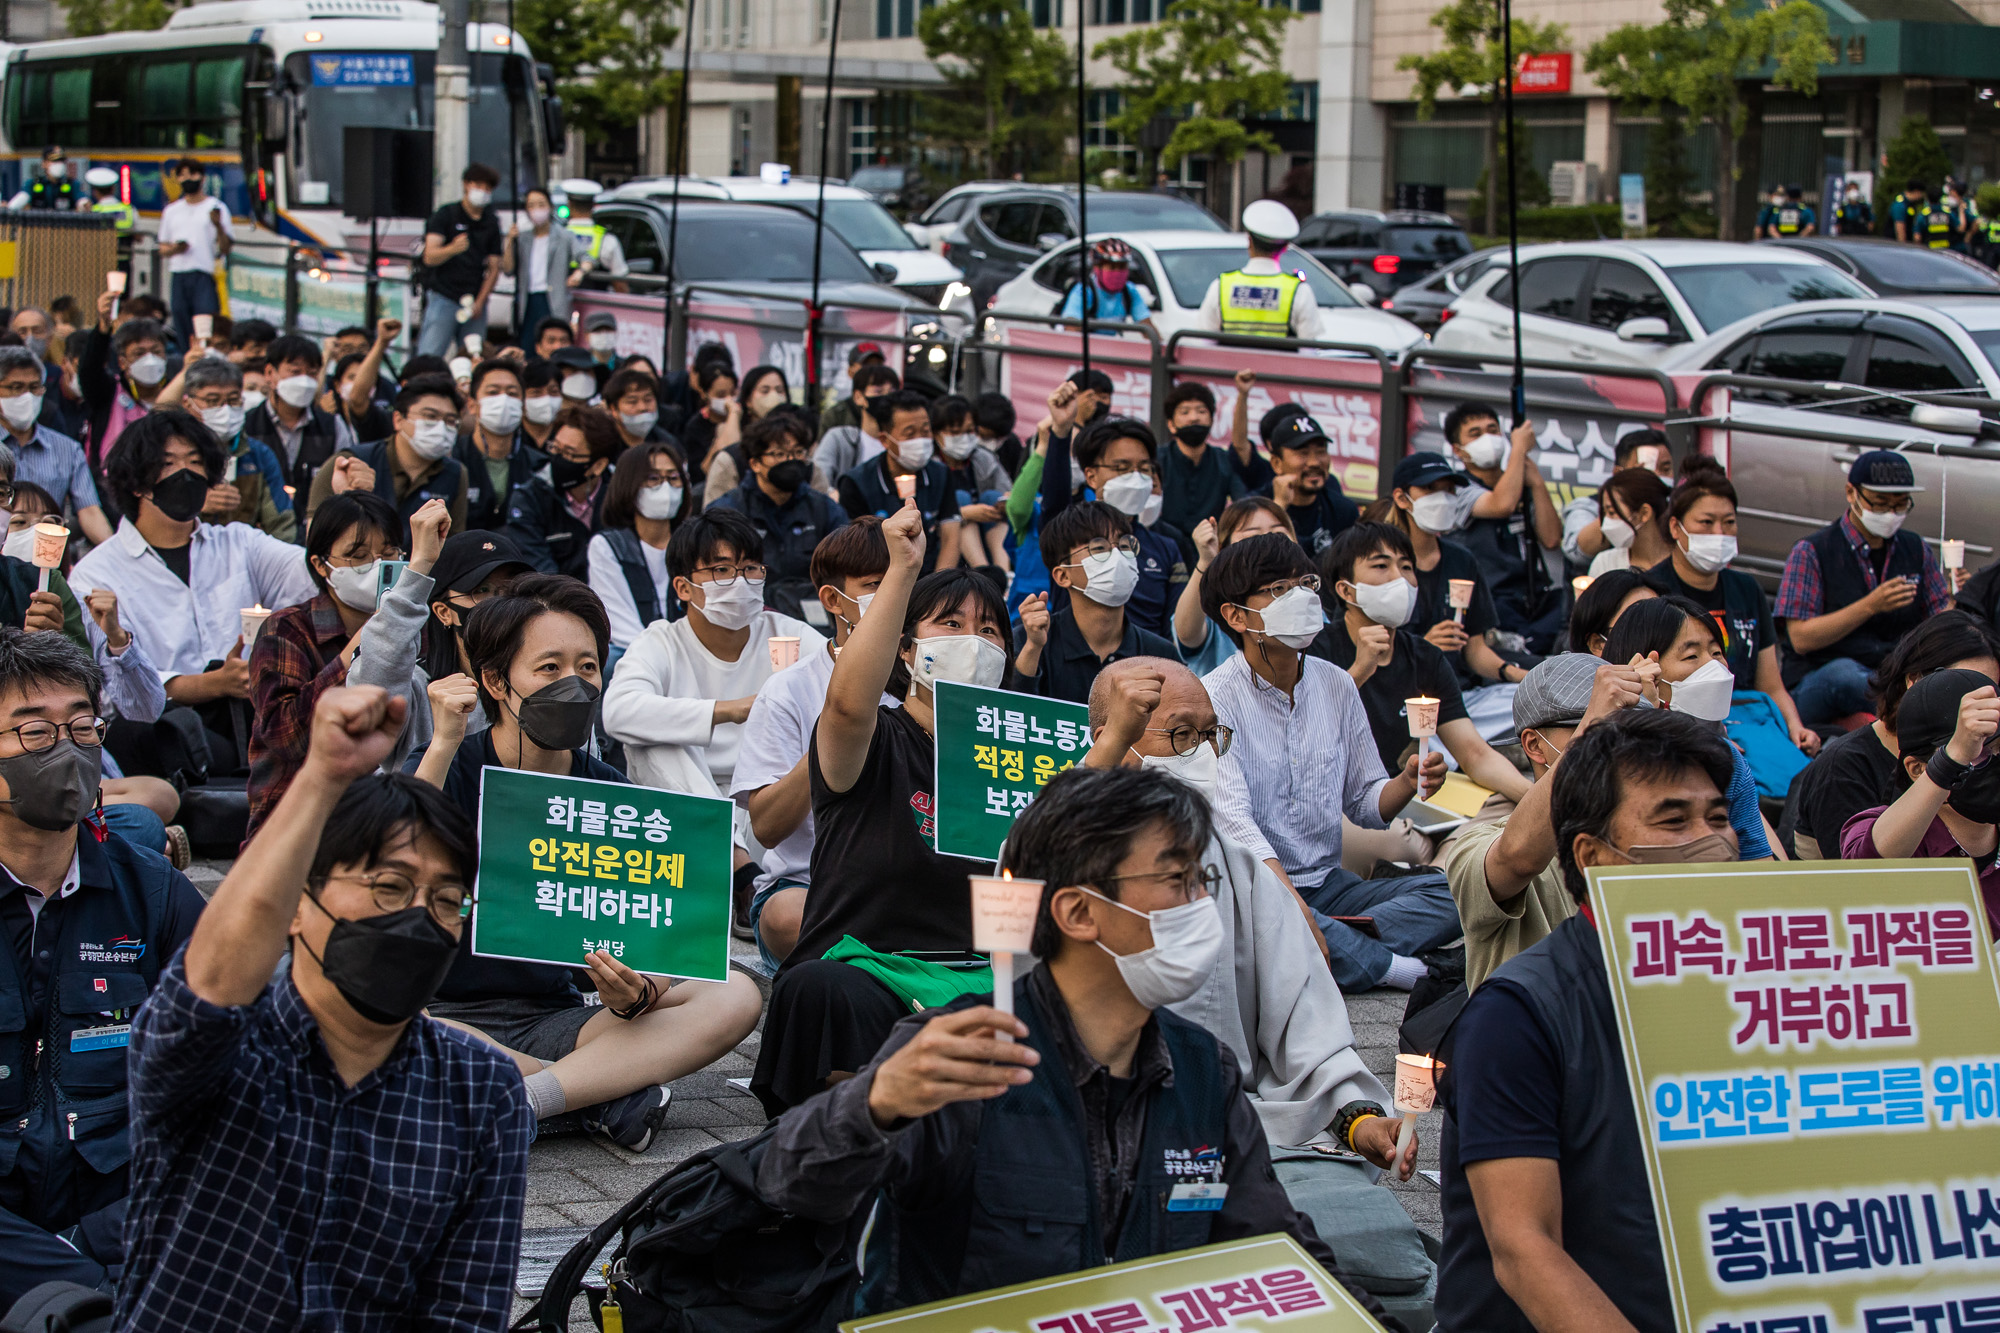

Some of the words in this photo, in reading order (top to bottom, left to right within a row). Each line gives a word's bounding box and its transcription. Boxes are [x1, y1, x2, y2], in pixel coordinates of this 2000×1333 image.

[974, 744, 1024, 782] 적정
[546, 795, 672, 843] 화물운송
[528, 838, 685, 889] 안전운임제
[535, 879, 673, 928] 확대하라!
[582, 937, 626, 958] 녹색당
[1631, 917, 1736, 978] 과속,
[1742, 914, 1842, 973] 과로,
[1847, 909, 1974, 968] 과적을
[1734, 983, 1911, 1045] 거부하고
[1655, 1074, 1791, 1142] 안전한
[1799, 1067, 1925, 1130] 도로를
[1709, 1195, 1921, 1284] 총파업에
[1160, 1268, 1327, 1333] 과적을
